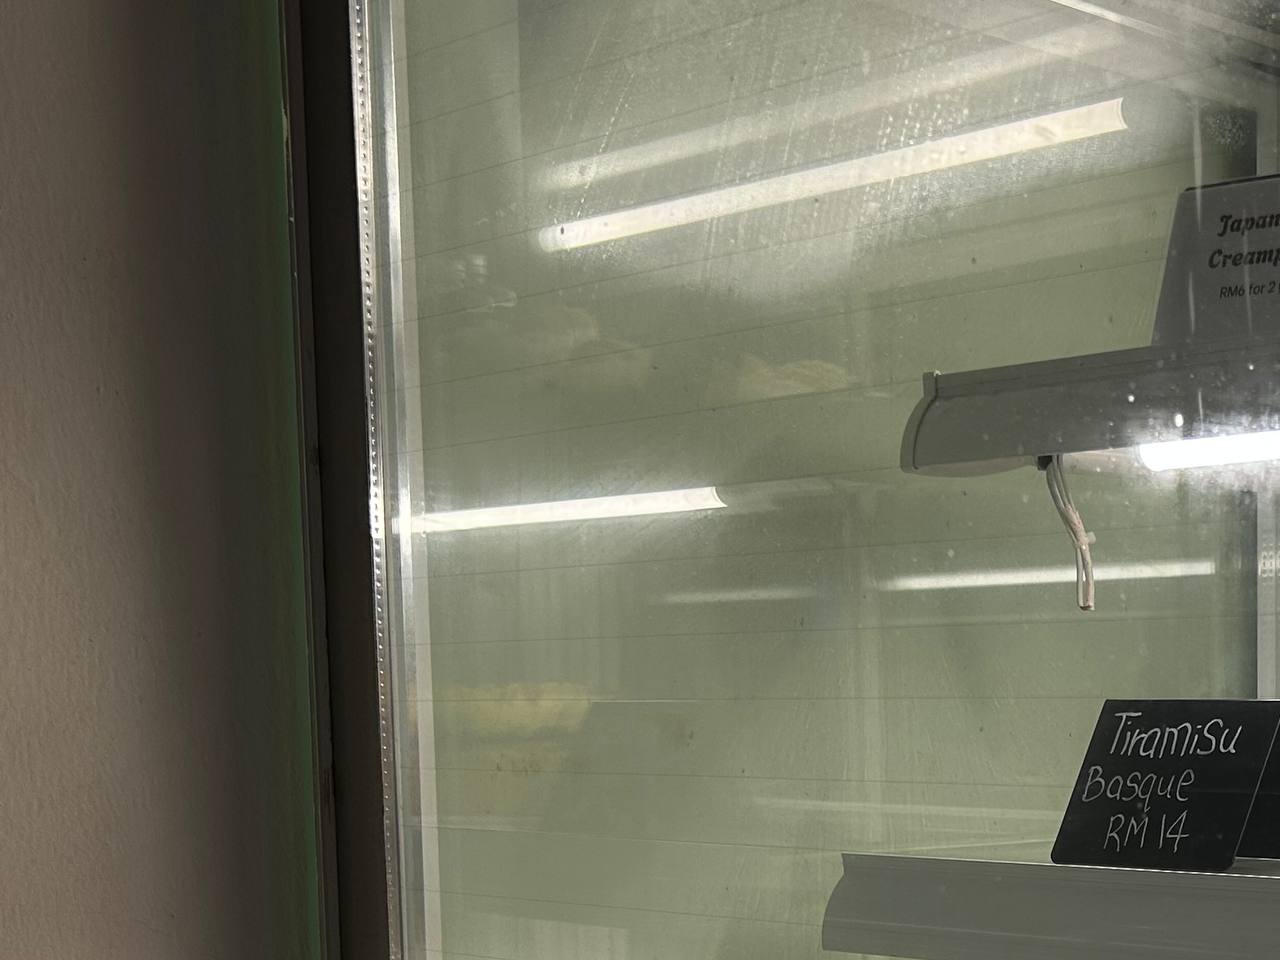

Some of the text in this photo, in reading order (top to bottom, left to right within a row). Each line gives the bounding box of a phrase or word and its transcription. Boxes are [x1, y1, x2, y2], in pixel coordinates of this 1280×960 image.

[1220, 284, 1245, 298] RM6
[1249, 283, 1265, 296] for
[1268, 281, 1276, 294] 2
[1082, 765, 1195, 813] Basque
